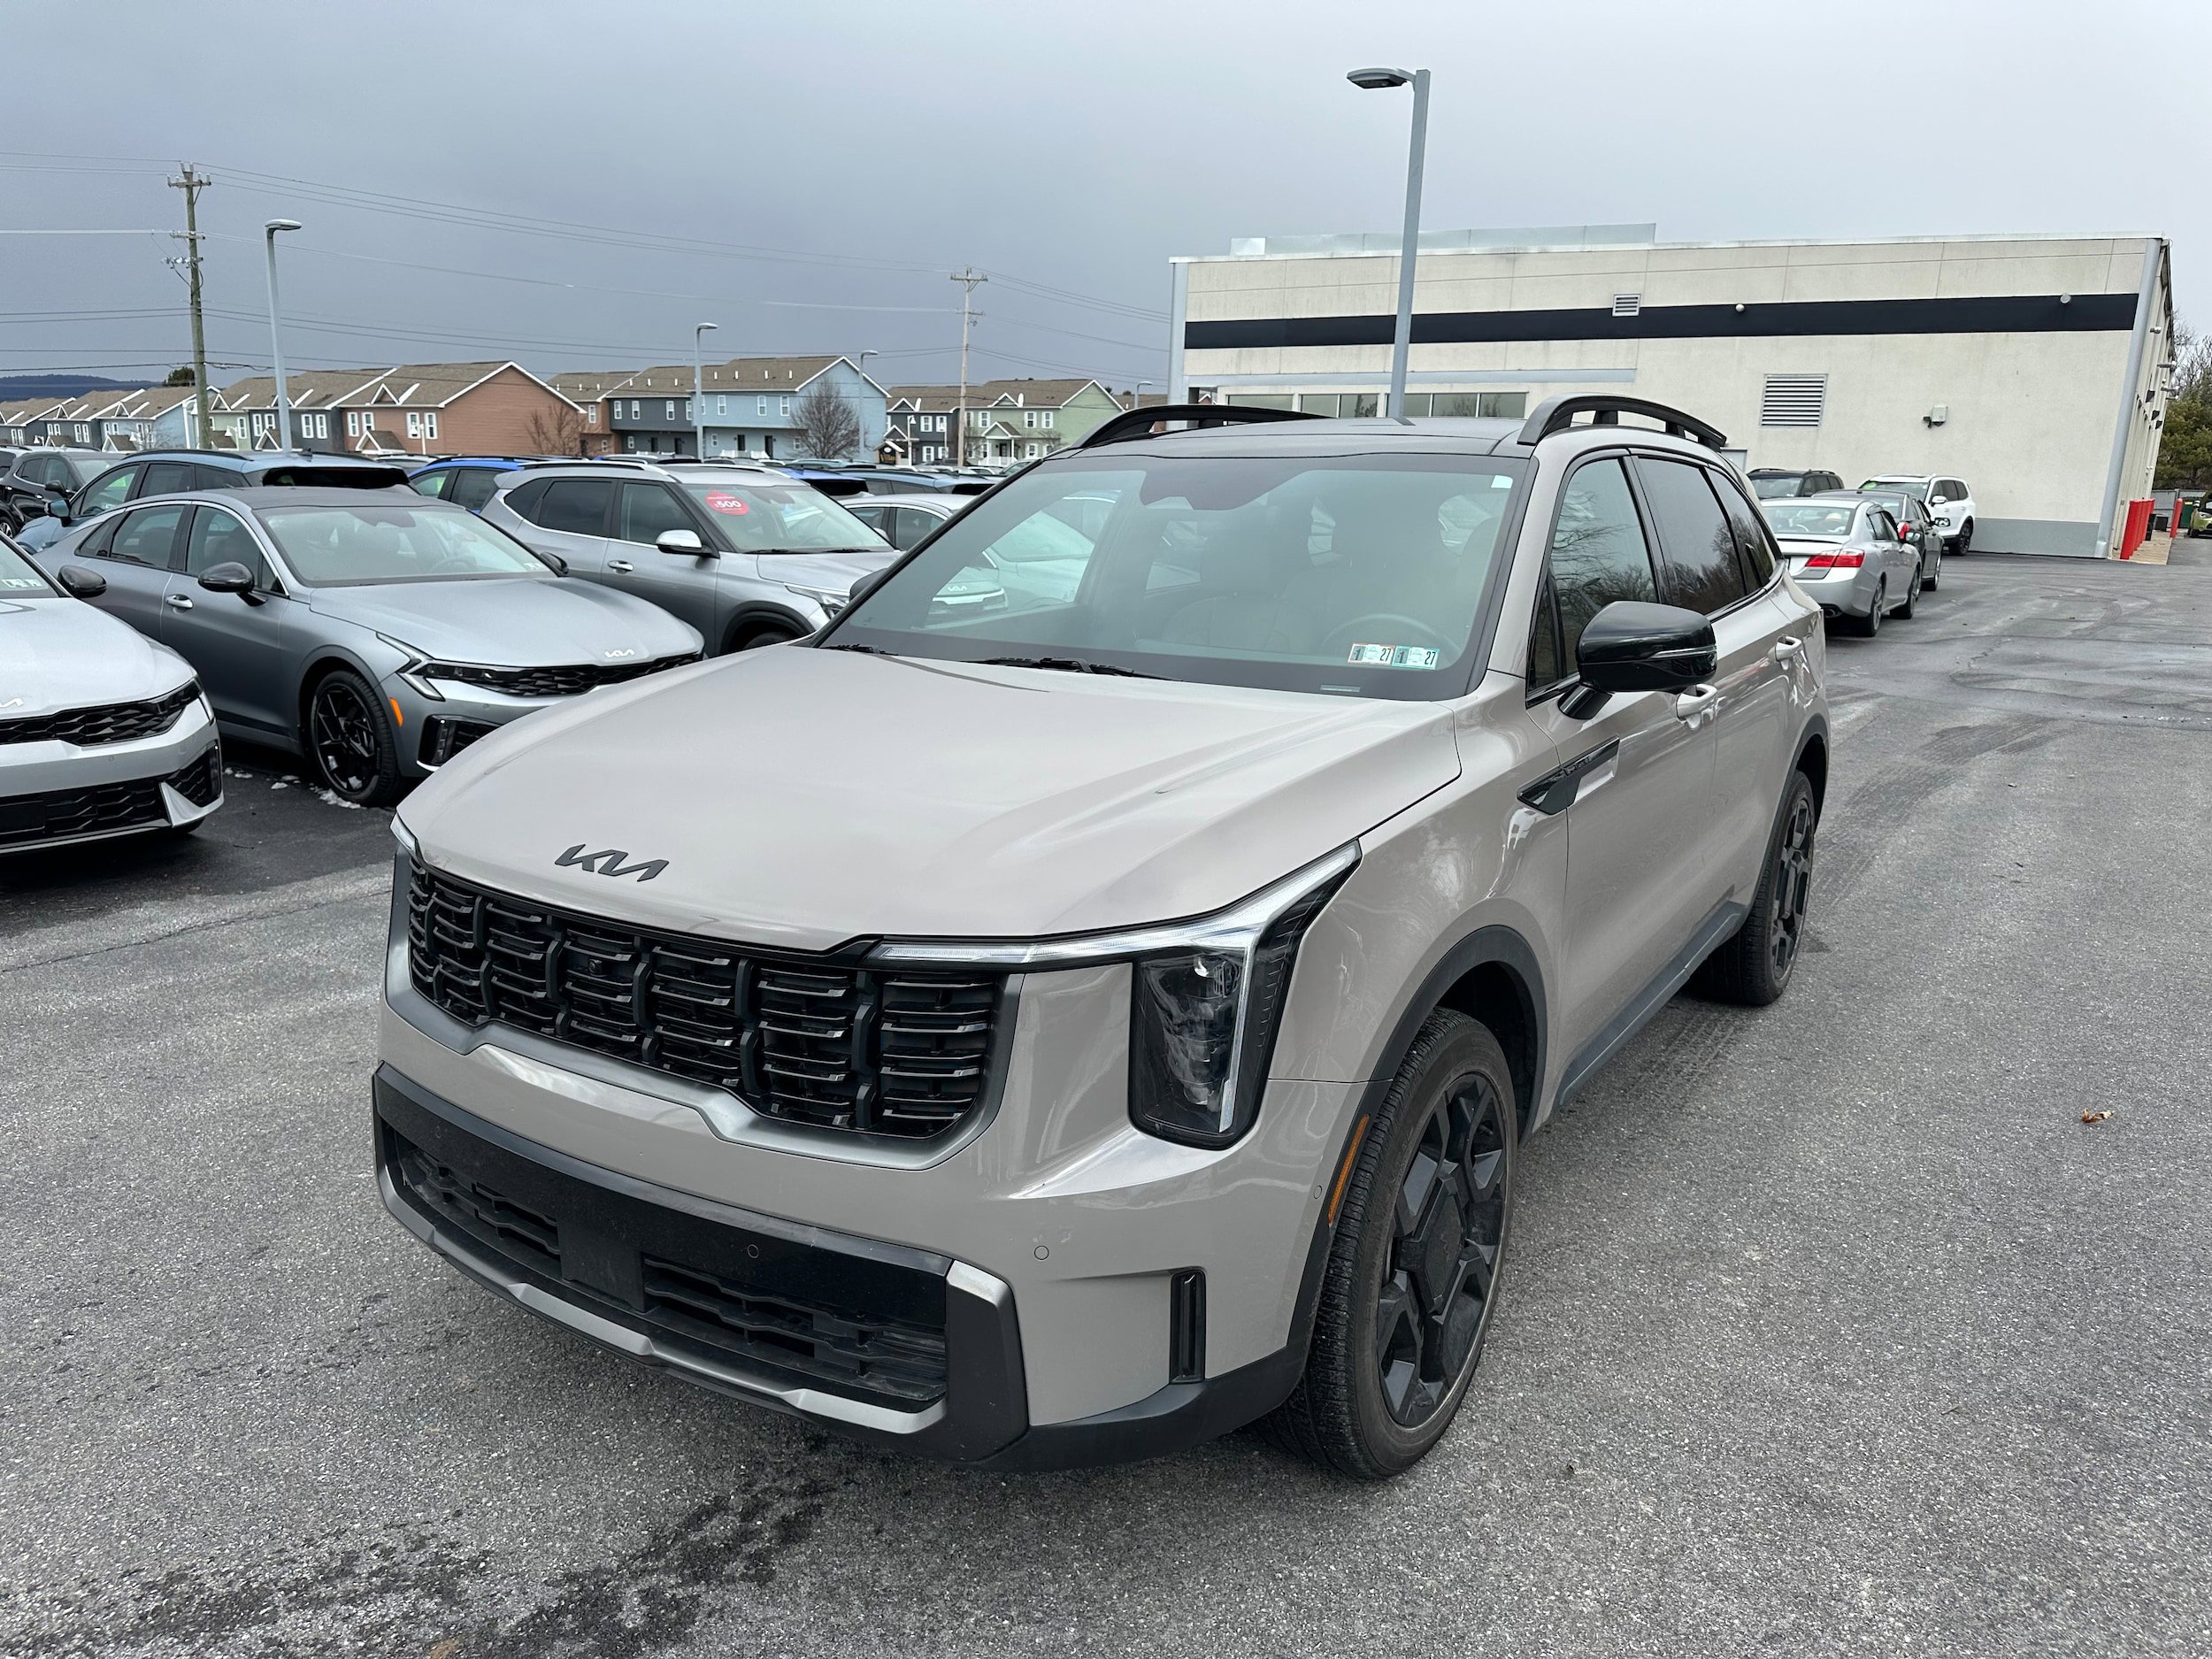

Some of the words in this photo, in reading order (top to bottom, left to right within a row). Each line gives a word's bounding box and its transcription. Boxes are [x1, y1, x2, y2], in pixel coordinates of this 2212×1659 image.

[604, 649, 635, 657] KIA
[1379, 648, 1392, 662] 27
[1424, 651, 1437, 665] 27
[554, 843, 670, 882] KIA
